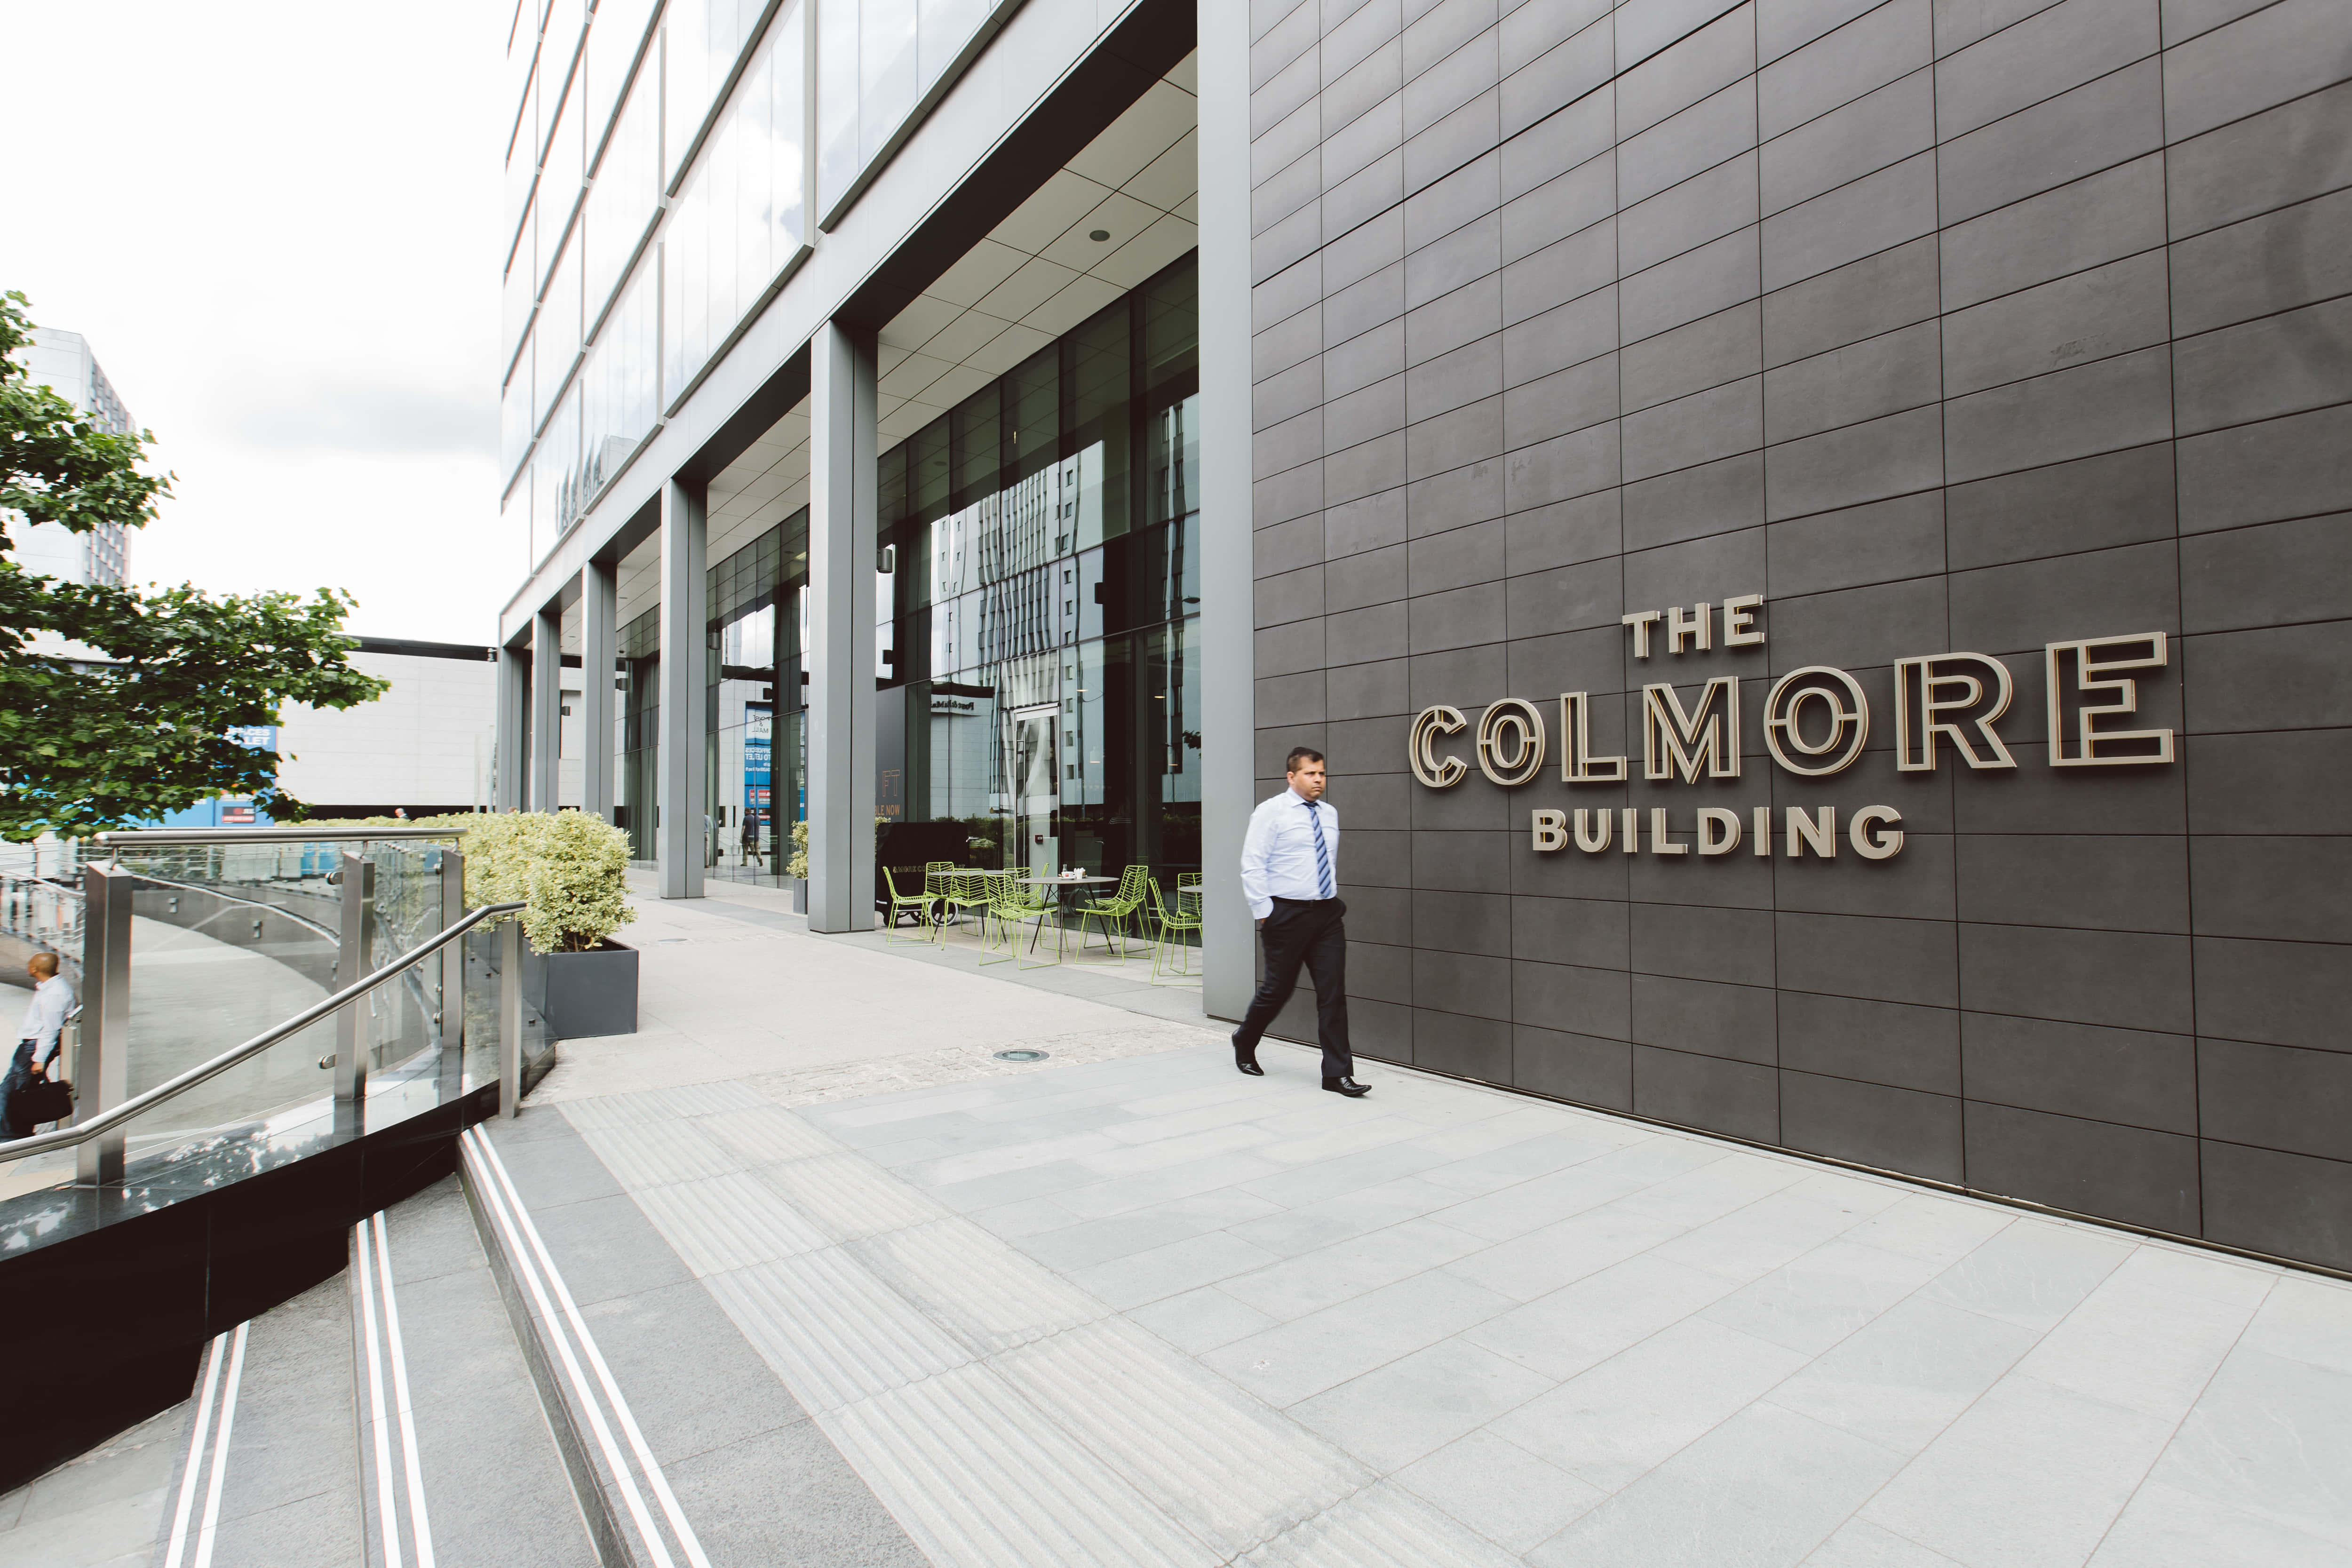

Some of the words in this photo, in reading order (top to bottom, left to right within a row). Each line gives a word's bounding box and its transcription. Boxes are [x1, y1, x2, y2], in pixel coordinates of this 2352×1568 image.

[1622, 594, 1766, 659] THE
[1408, 631, 2175, 788] COLMORE
[882, 769, 900, 797] FT
[886, 804, 900, 816] NOW
[1532, 805, 1904, 860] BUILDING
